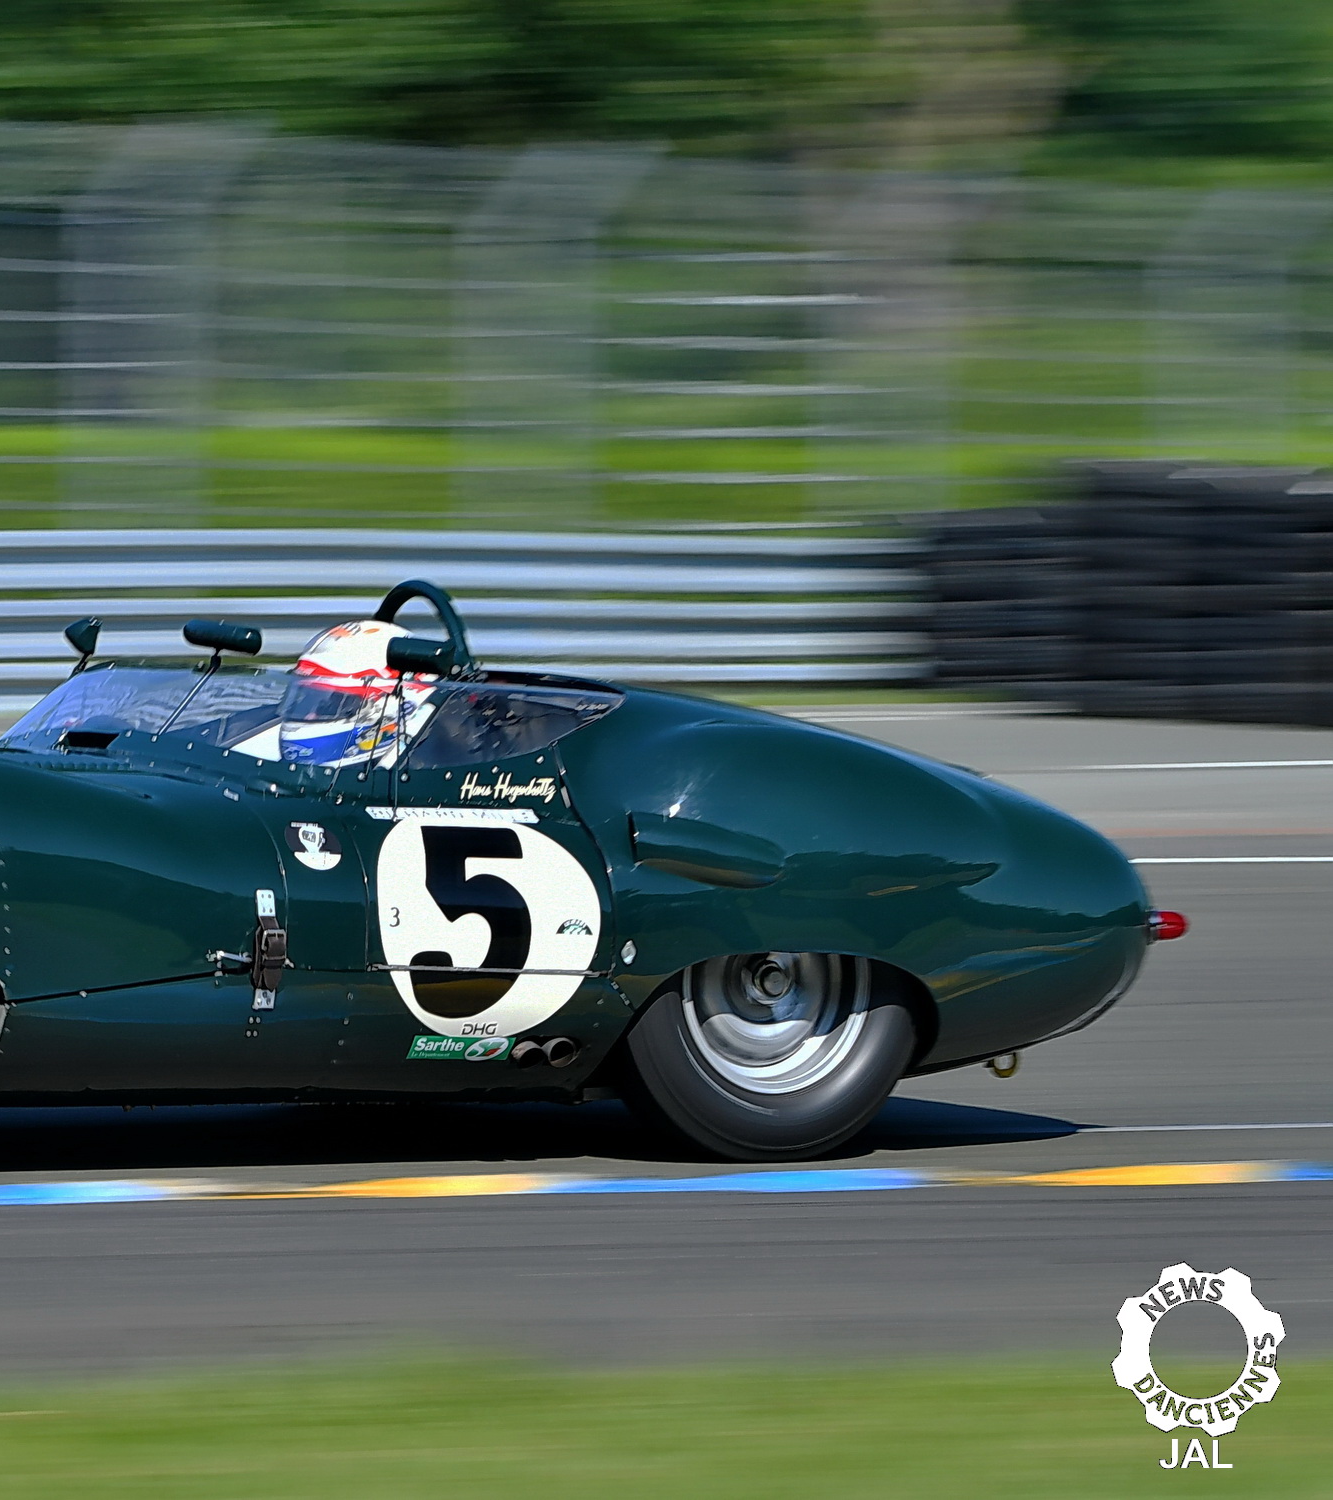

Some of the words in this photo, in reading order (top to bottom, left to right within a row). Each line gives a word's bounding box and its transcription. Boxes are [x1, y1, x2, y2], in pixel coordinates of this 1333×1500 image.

[389, 907, 401, 927] 3
[409, 826, 532, 1019] 5
[461, 1023, 498, 1035] DHG
[414, 1037, 465, 1051] Sarthe
